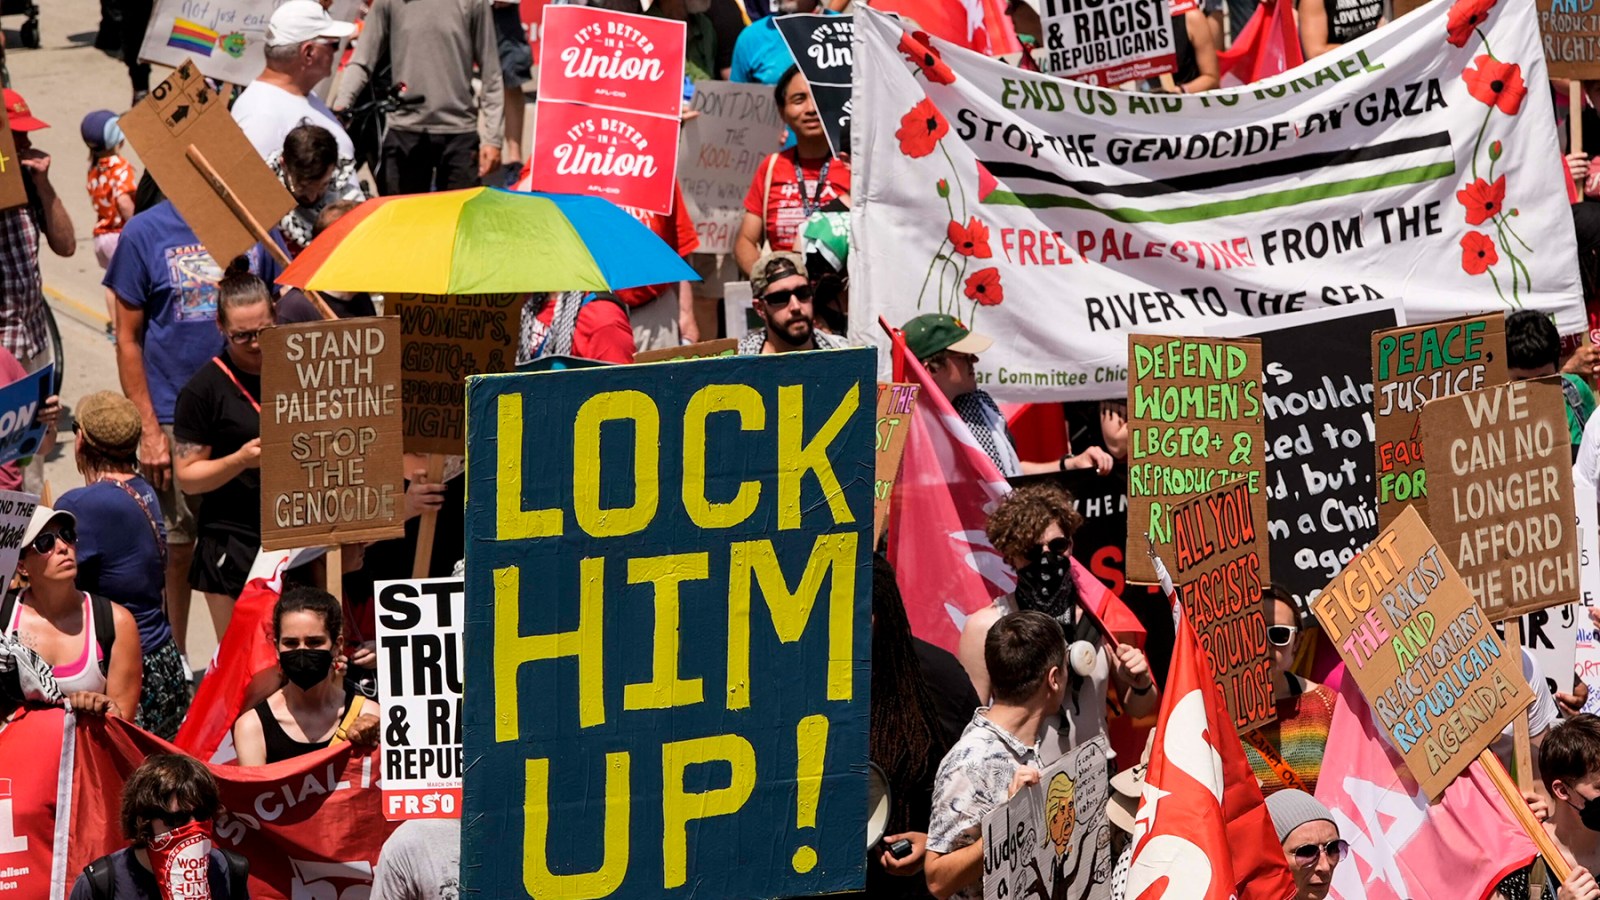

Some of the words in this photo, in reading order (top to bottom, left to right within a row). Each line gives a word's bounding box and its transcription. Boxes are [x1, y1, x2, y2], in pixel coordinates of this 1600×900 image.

[1074, 0, 1164, 45] RACIST
[1550, 0, 1593, 14] AND
[574, 22, 602, 45] IT'S
[607, 21, 654, 55] BETTER
[604, 37, 615, 47] IN
[811, 24, 833, 43] IT'S
[1048, 23, 1065, 50] &
[1050, 28, 1169, 72] REPUBLICANS
[560, 46, 665, 82] Union
[740, 93, 778, 126] DRIN
[1001, 78, 1066, 112] END
[1074, 86, 1117, 116] US
[1128, 97, 1183, 115] AID
[566, 119, 595, 141] IT'S
[601, 117, 648, 151] BETTER
[597, 135, 608, 144] IN
[956, 109, 1042, 158] STOP
[1046, 134, 1100, 168] THE
[1107, 122, 1290, 166] GENOCIDE
[1354, 78, 1448, 127] GAZA
[553, 143, 658, 178] Union
[1000, 228, 1074, 265] FREE
[1261, 213, 1364, 265] FROM
[1373, 201, 1443, 245] THE
[1085, 291, 1183, 332] RIVER
[1181, 287, 1229, 317] TO
[1239, 287, 1306, 316] THE
[286, 328, 385, 362] STAND
[1134, 340, 1247, 382] DEFEND
[296, 356, 373, 390] WITH
[976, 371, 992, 384] ar
[999, 367, 1088, 386] Committee
[1095, 365, 1128, 383] Chic
[1379, 365, 1486, 417] JUSTICE
[275, 384, 395, 425] PALESTINE
[886, 385, 918, 415] THE
[1462, 382, 1529, 429] WE
[291, 426, 378, 460] STOP
[1133, 426, 1224, 460] LBGTQ+
[1229, 431, 1251, 466] &
[1322, 423, 1362, 449] to
[1450, 430, 1506, 476] CAN
[1514, 420, 1553, 462] NO
[301, 457, 365, 488] THE
[496, 380, 860, 541] LOCK
[275, 484, 395, 528] GENOCIDE
[1380, 469, 1428, 504] FOR
[1453, 466, 1560, 523] LONGER
[0, 501, 14, 514] ND
[15, 502, 36, 517] THE
[1174, 501, 1214, 573] ALL
[1208, 482, 1255, 551] YOU
[1297, 513, 1317, 534] a
[1458, 513, 1562, 570] AFFORD
[1182, 552, 1263, 632] FASCISTS
[1314, 529, 1405, 643] FIGHT
[1461, 570, 1504, 611] HE
[1511, 552, 1575, 602] RICH
[379, 582, 464, 630] ST
[1342, 607, 1390, 669] THE
[1381, 544, 1446, 629] RACIST
[493, 531, 858, 743] HIM
[1200, 610, 1268, 679] BOUND
[1391, 611, 1436, 675] AND
[381, 632, 464, 697] TRU
[1375, 602, 1483, 730] REACTIONARY
[1234, 659, 1278, 728] LOSE
[1392, 632, 1501, 754] REPUBLICAN
[386, 704, 411, 747] &
[1422, 667, 1519, 776] AGENDA
[1250, 730, 1284, 768] LANET
[216, 756, 374, 846] SOCIALI
[523, 714, 829, 900] UP!
[984, 807, 1025, 875] Judge
[0, 867, 29, 878] alism
[997, 878, 1009, 900] a
